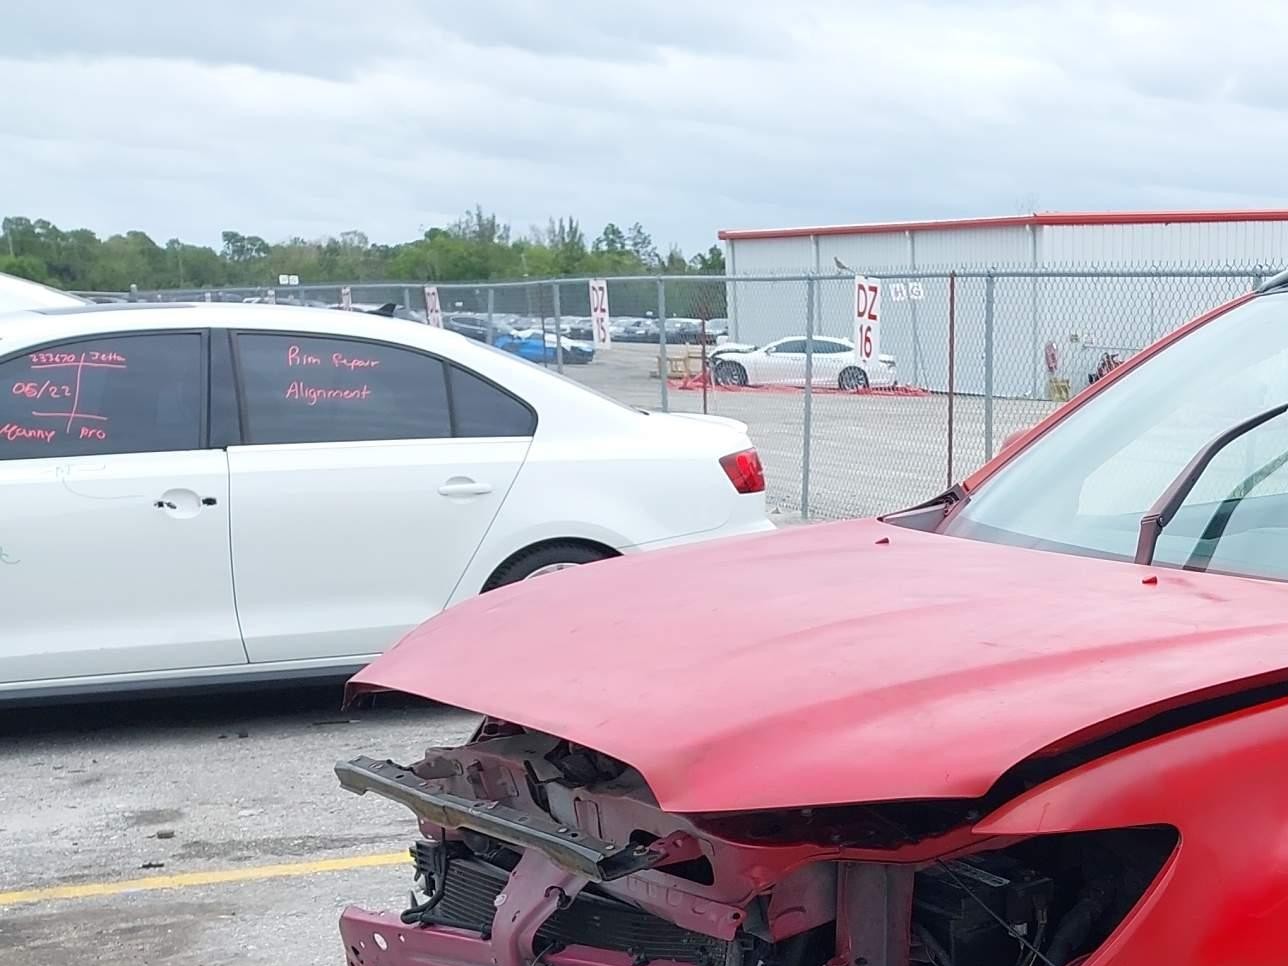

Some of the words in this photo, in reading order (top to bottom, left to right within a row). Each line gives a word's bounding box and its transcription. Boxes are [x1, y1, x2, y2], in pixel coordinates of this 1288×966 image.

[592, 286, 606, 312] DZ
[857, 283, 878, 320] DZ
[860, 324, 872, 358] 16
[286, 381, 371, 406] Alignment
